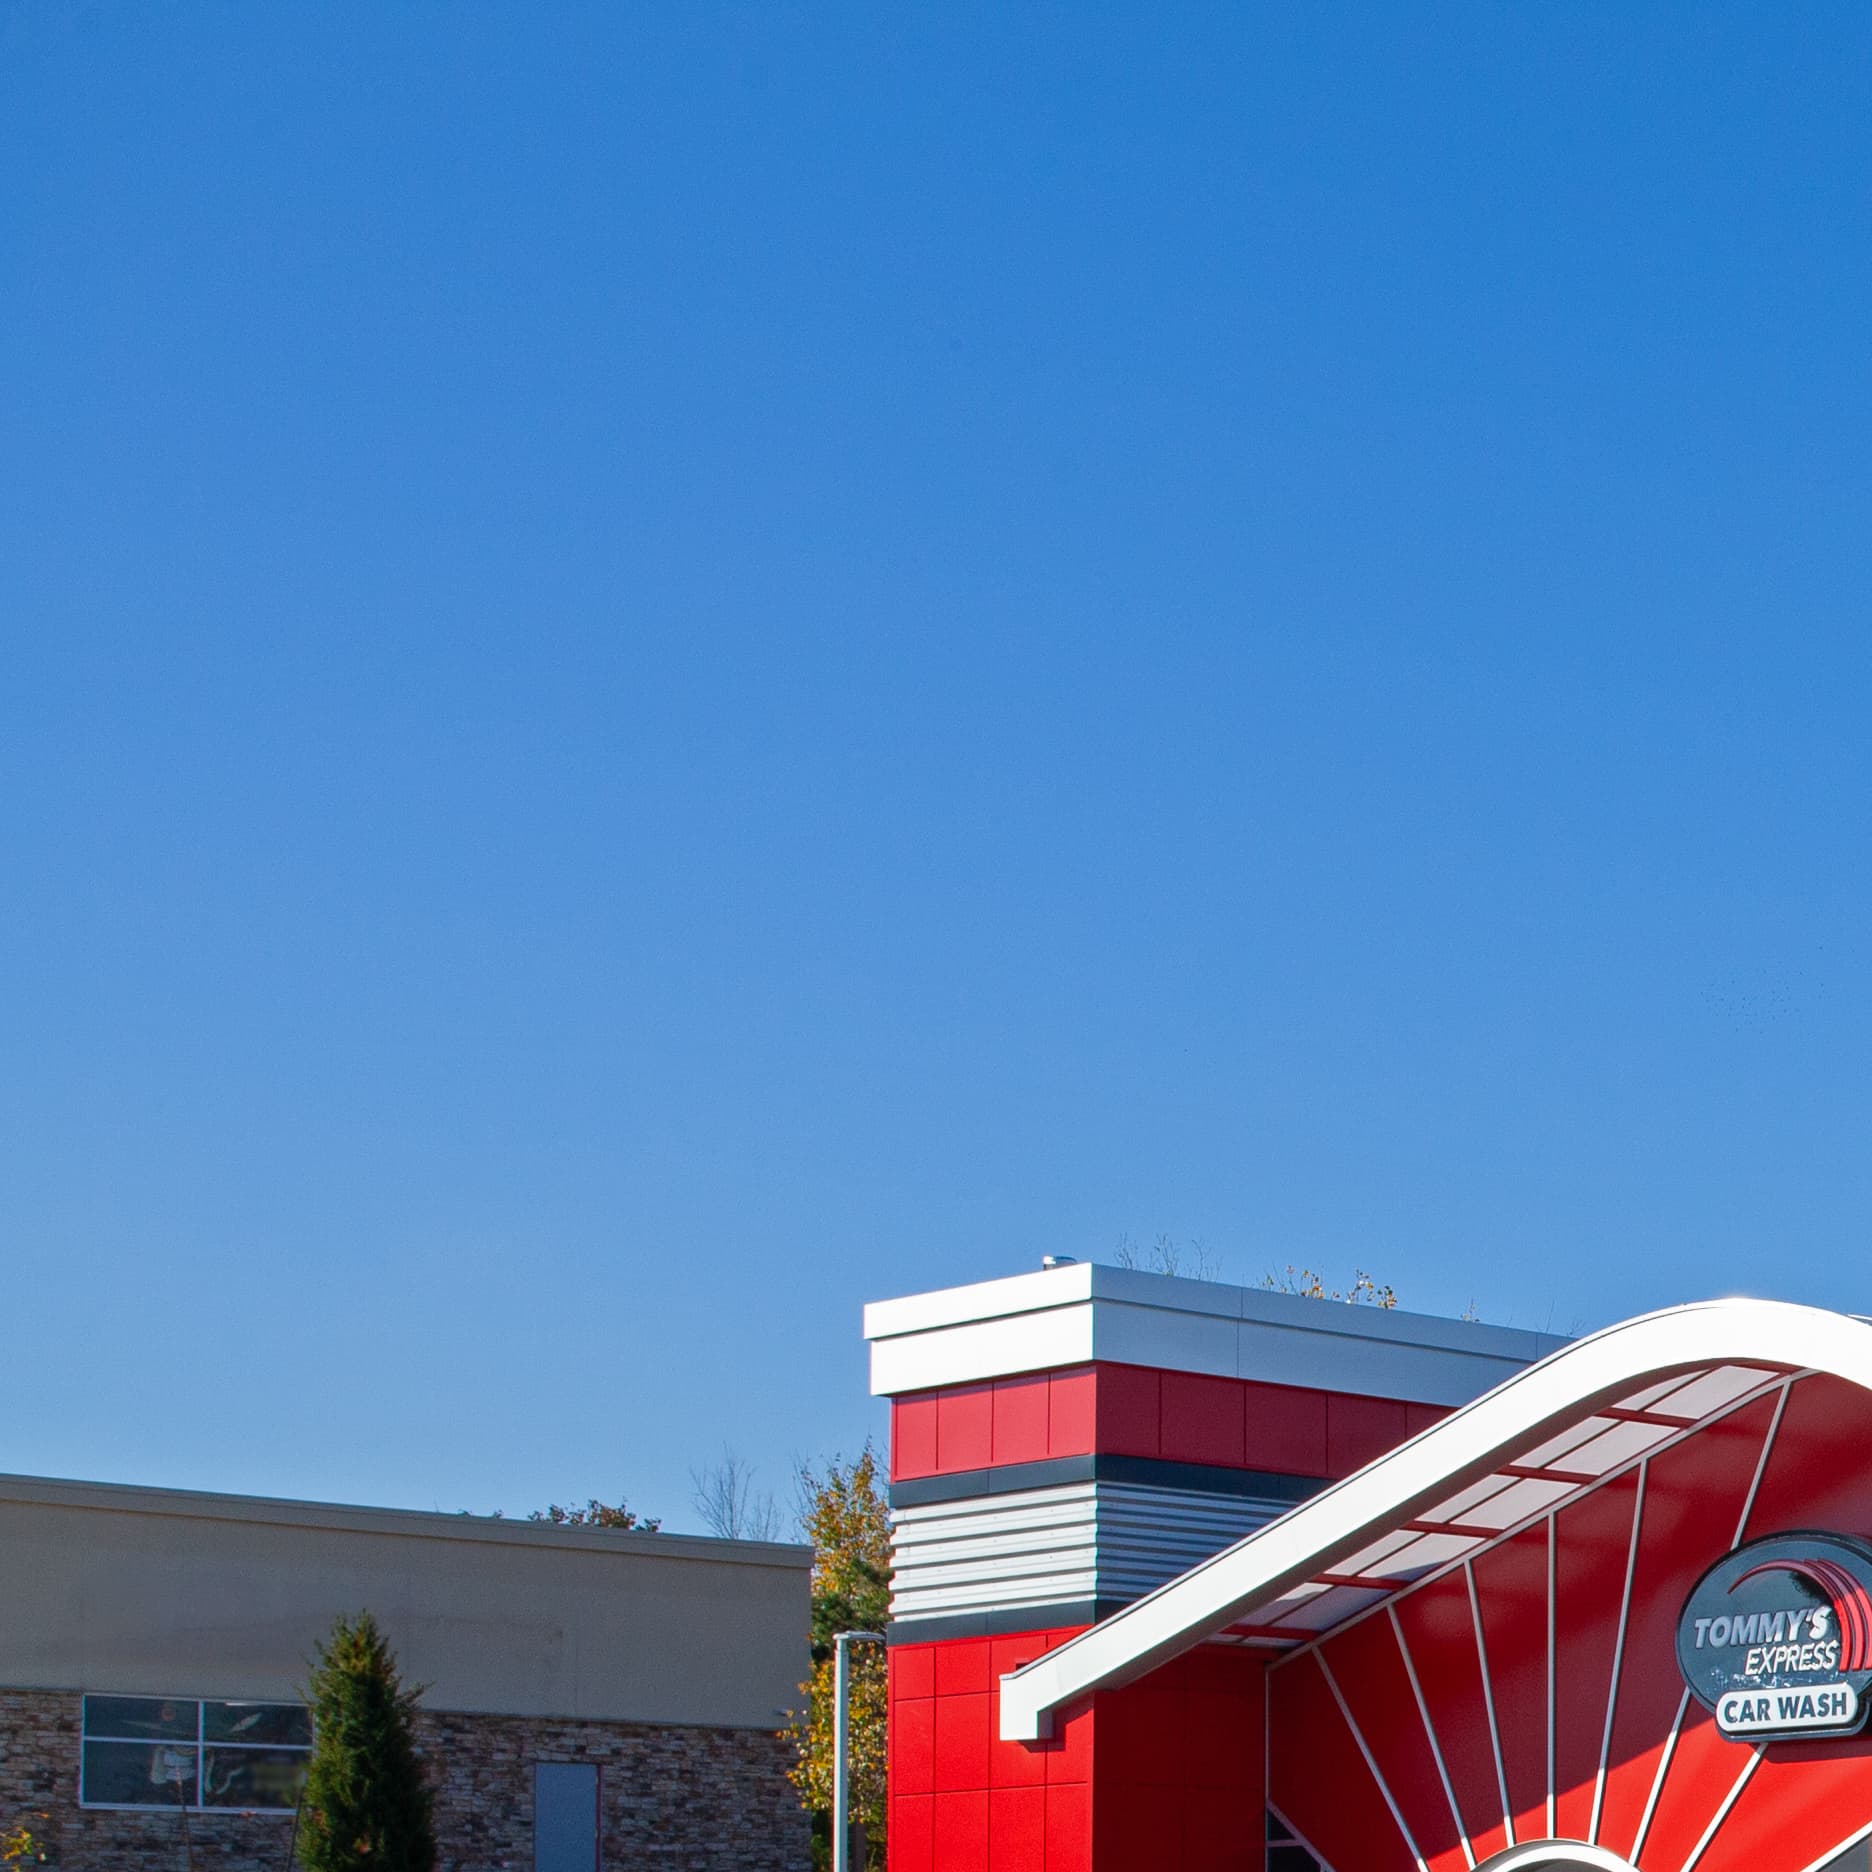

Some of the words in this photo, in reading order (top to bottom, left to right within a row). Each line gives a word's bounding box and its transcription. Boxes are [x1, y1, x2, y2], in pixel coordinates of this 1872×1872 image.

[1695, 1605, 1832, 1649] TOMMY'S
[1745, 1640, 1840, 1676] EXPRESS
[1723, 1698, 1770, 1723] CAR
[1777, 1692, 1848, 1719] WASH
